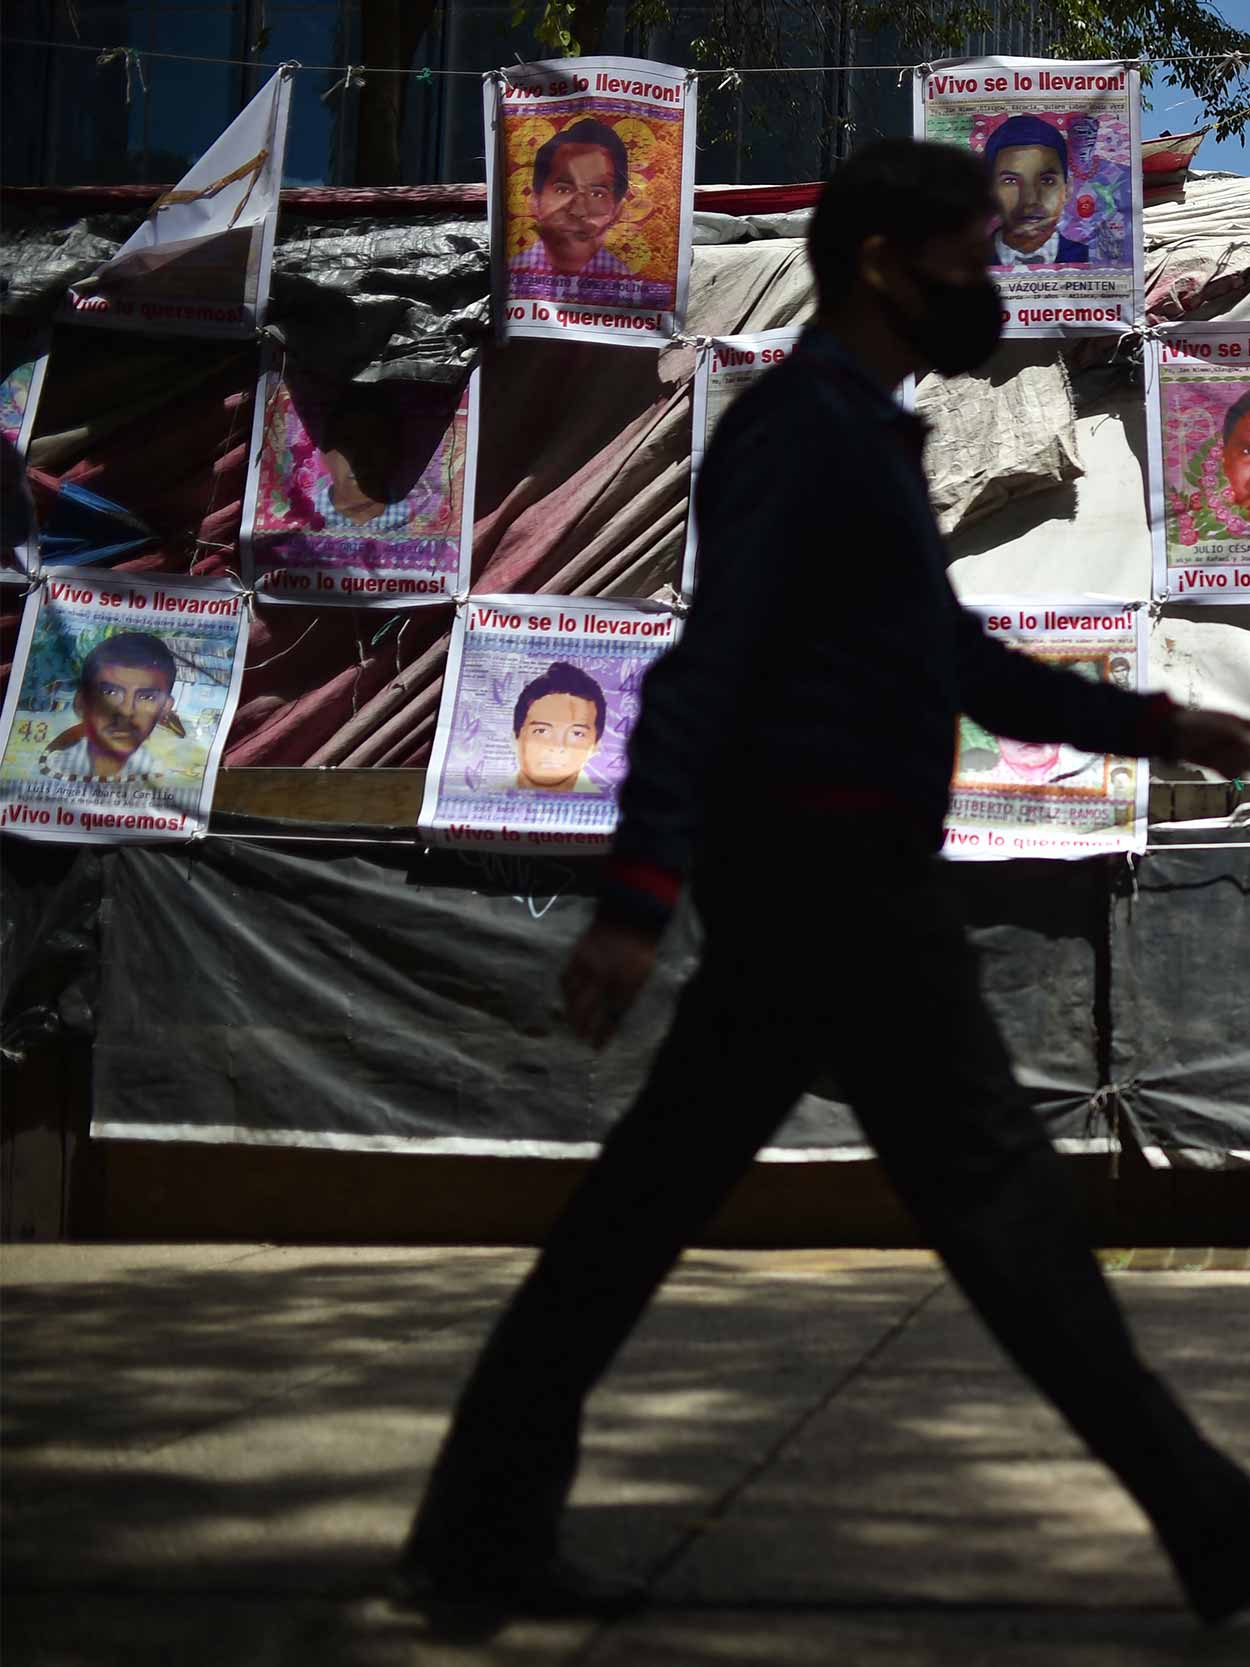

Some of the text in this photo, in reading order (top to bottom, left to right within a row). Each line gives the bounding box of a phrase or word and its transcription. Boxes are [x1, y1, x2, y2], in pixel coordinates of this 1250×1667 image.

[550, 82, 568, 97] se
[573, 74, 590, 94] lo
[595, 73, 682, 103] llevaron!
[928, 71, 1126, 100] ¡Vivo se lo llevaron!
[1008, 280, 1059, 294] VÁZQUEZ
[1065, 281, 1116, 292] PENITEN
[531, 302, 550, 321] lo
[556, 308, 663, 331] queremos!
[1018, 303, 1122, 326] queremos!
[711, 347, 755, 373] ¡Vivo
[761, 347, 785, 364] se
[1161, 338, 1211, 363] ¡Vivo
[1217, 341, 1241, 358] se
[1193, 544, 1224, 554] JULIO
[263, 568, 446, 594] ¡Vivo lo queremos!
[1178, 570, 1227, 592] ¡Vivo
[43, 582, 239, 617] ¡Vivo se lo llevaron!
[469, 608, 673, 637] ¡Vivo se lo llevaron!
[987, 611, 1132, 631] se lo llevaron!
[26, 784, 50, 793] Luis
[1, 804, 188, 832] ¡Vivo lo queremos!
[502, 825, 521, 842] lo
[988, 831, 1005, 847] lo
